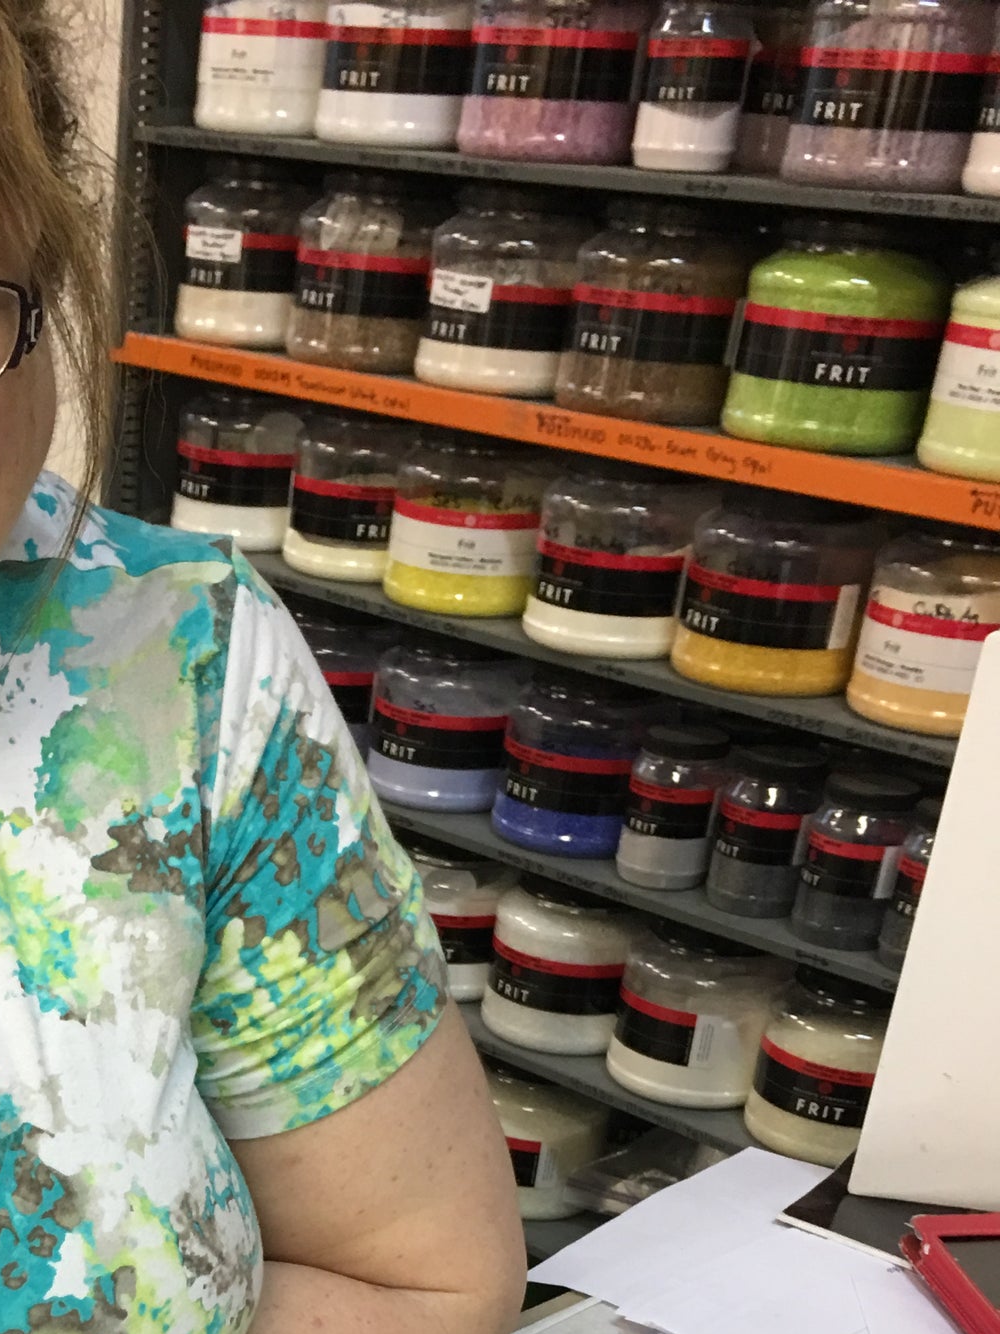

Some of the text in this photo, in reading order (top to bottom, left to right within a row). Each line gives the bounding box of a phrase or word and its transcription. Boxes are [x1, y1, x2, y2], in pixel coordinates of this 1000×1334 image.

[340, 70, 381, 88] FRIT
[487, 74, 531, 93] FRIT
[659, 86, 696, 102] FRIT
[762, 92, 794, 110] FRI
[813, 100, 863, 121] FRIT
[980, 107, 1000, 126] FRI
[580, 332, 621, 352] FRIT
[815, 363, 871, 385] FRIT
[180, 479, 209, 498] FRIT
[356, 523, 387, 538] FRI
[538, 581, 573, 604] FRIT
[686, 608, 720, 632] FRIT
[382, 739, 416, 761] FRIT
[506, 779, 538, 801] FRIT
[629, 817, 658, 835] FRIT
[497, 979, 530, 1002] FRIT
[796, 1098, 845, 1121] FRIT
